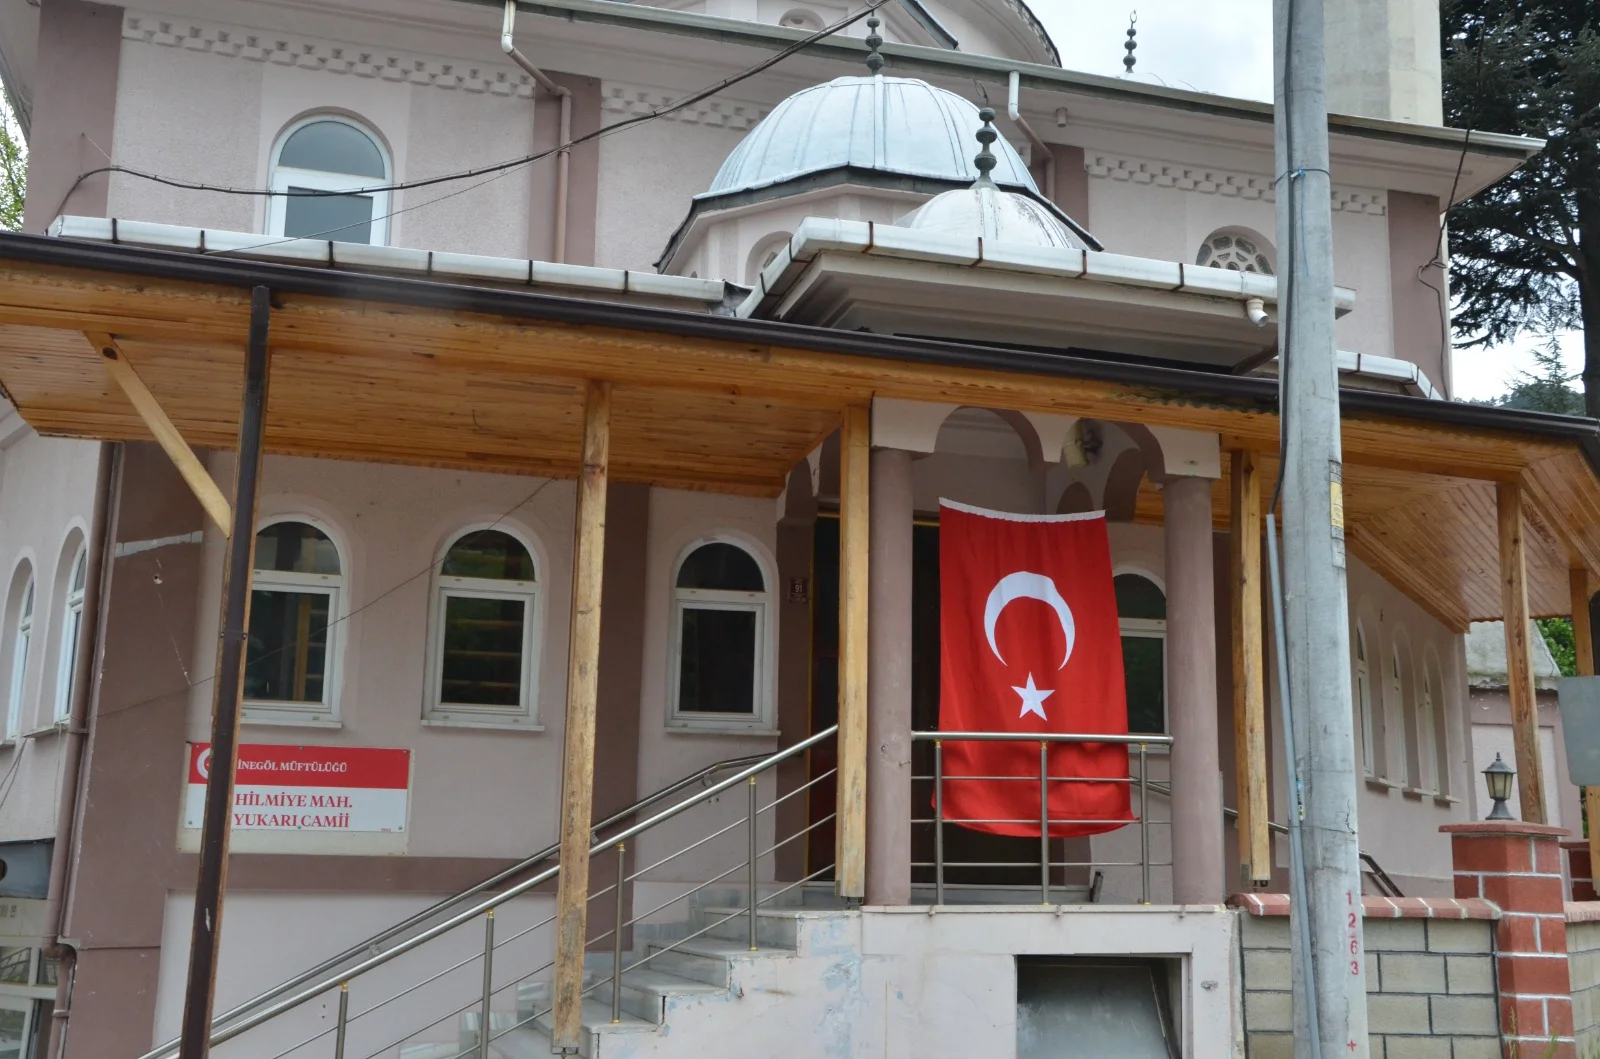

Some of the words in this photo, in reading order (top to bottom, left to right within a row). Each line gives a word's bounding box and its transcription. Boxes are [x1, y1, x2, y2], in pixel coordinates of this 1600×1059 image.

[237, 758, 278, 771] İNEGÖL
[280, 760, 347, 773] MÜFTÜLÜĞÜ
[235, 791, 307, 807] HİLMİYE
[310, 795, 353, 808] MAH.
[233, 814, 298, 827] YUKARI
[300, 813, 350, 827] CAMİİ
